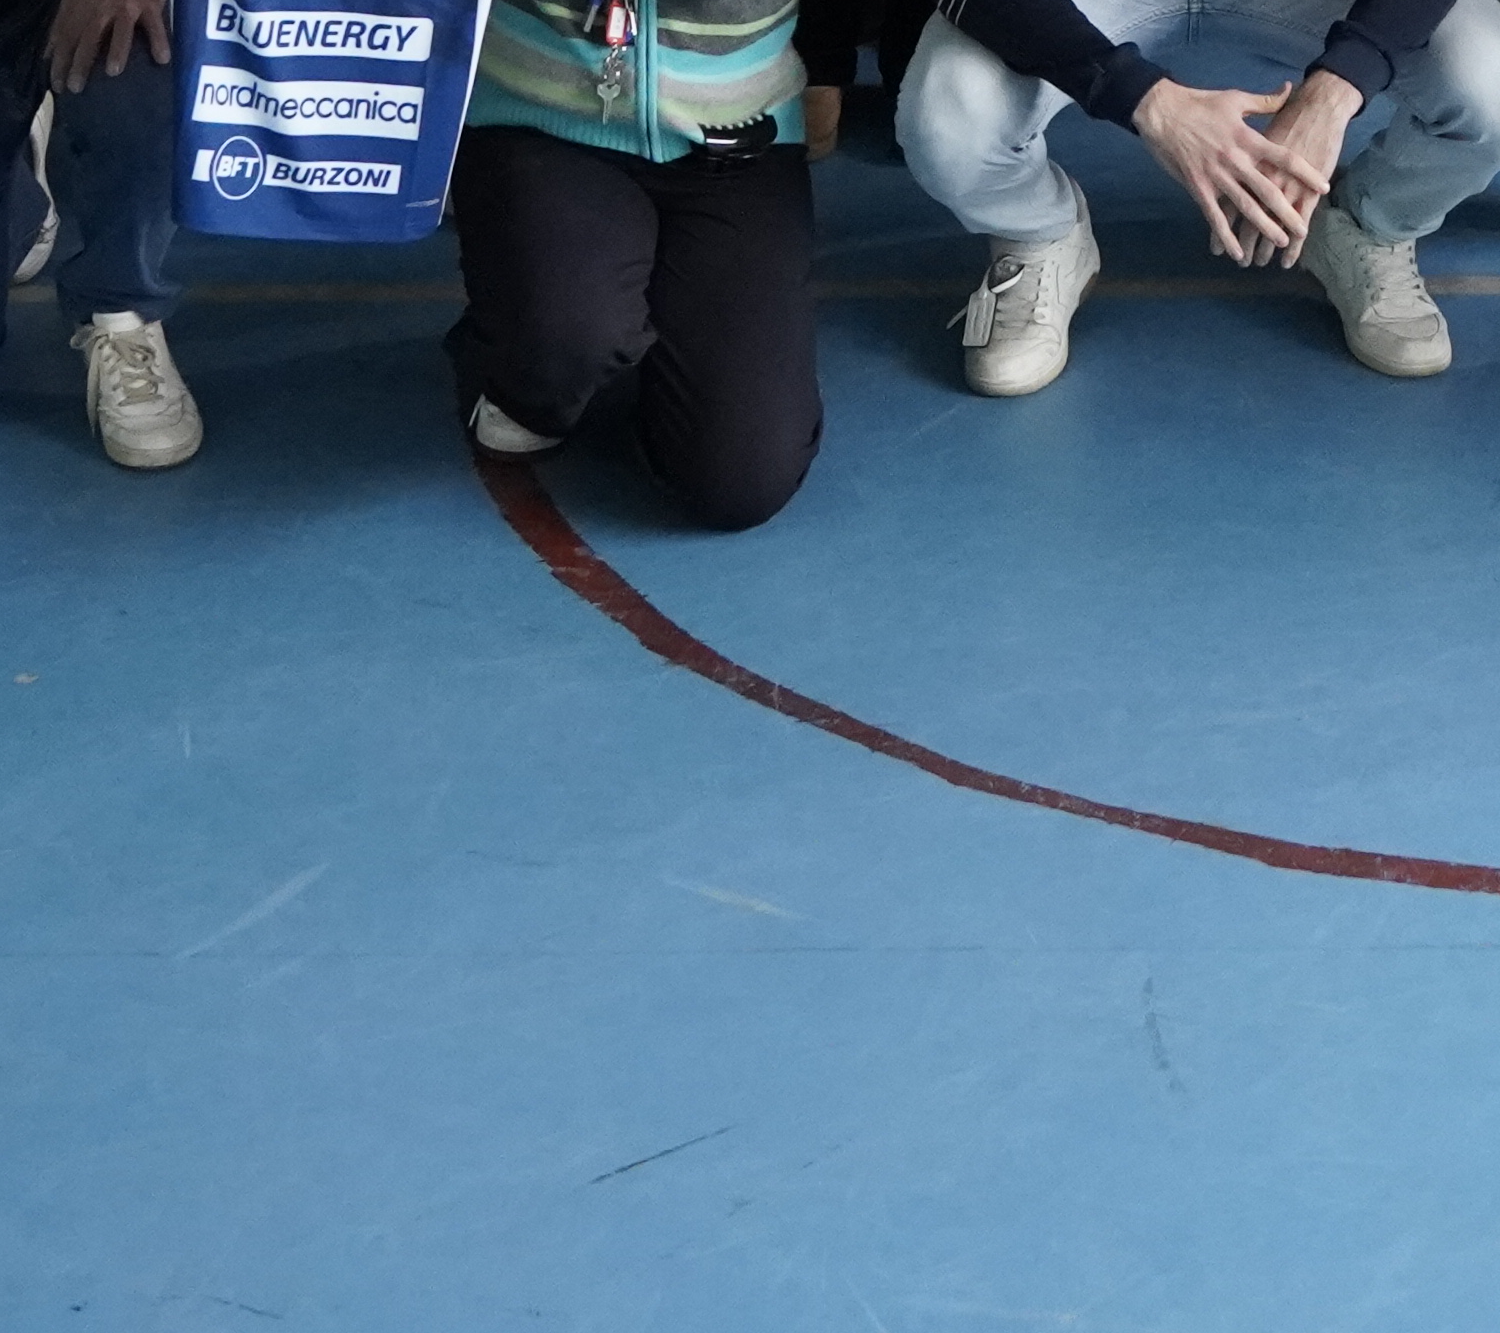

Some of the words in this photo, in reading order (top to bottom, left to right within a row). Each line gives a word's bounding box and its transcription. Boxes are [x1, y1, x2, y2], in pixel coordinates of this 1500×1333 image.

[200, 81, 419, 124] nordmeccanica
[216, 154, 260, 179] BFT
[271, 161, 392, 188] BURZONI
